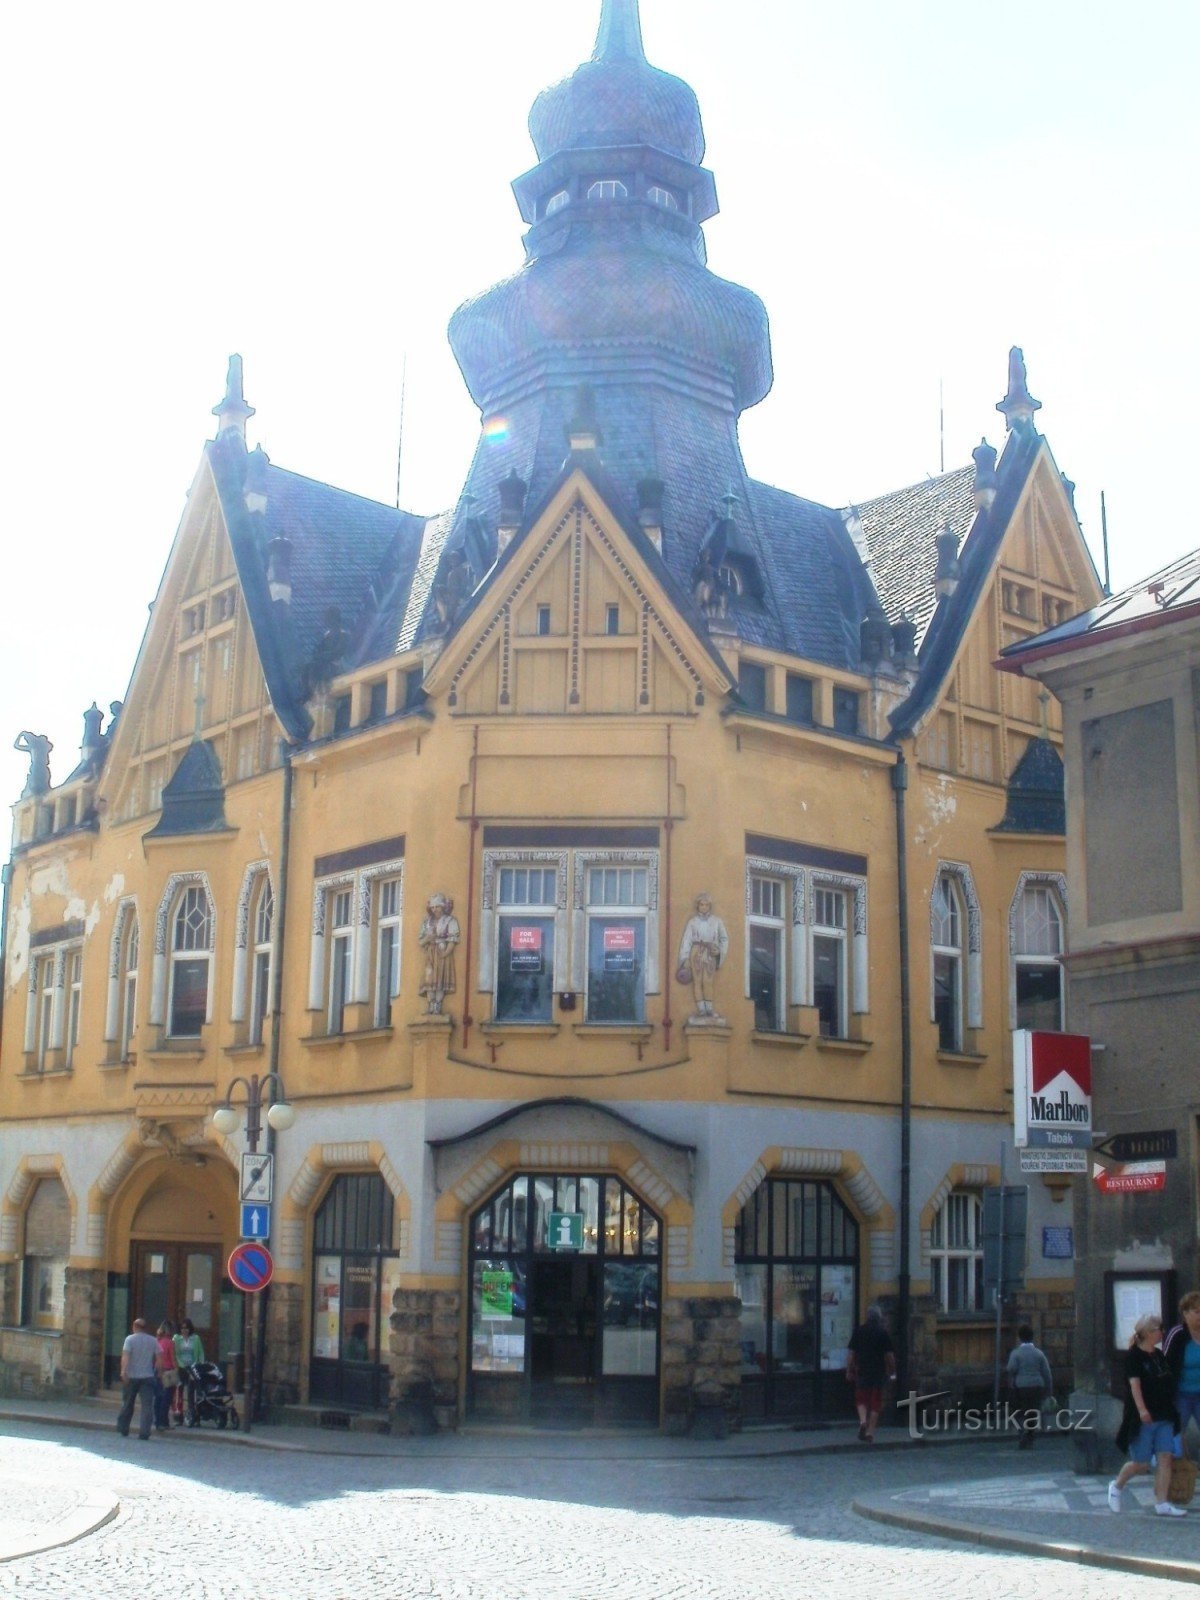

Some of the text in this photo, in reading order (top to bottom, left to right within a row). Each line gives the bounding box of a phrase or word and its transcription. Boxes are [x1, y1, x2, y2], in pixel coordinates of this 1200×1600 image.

[1030, 1091, 1089, 1123] Marlboro
[1046, 1131, 1073, 1145] Tabák
[1106, 1177, 1159, 1189] RESTAURANT
